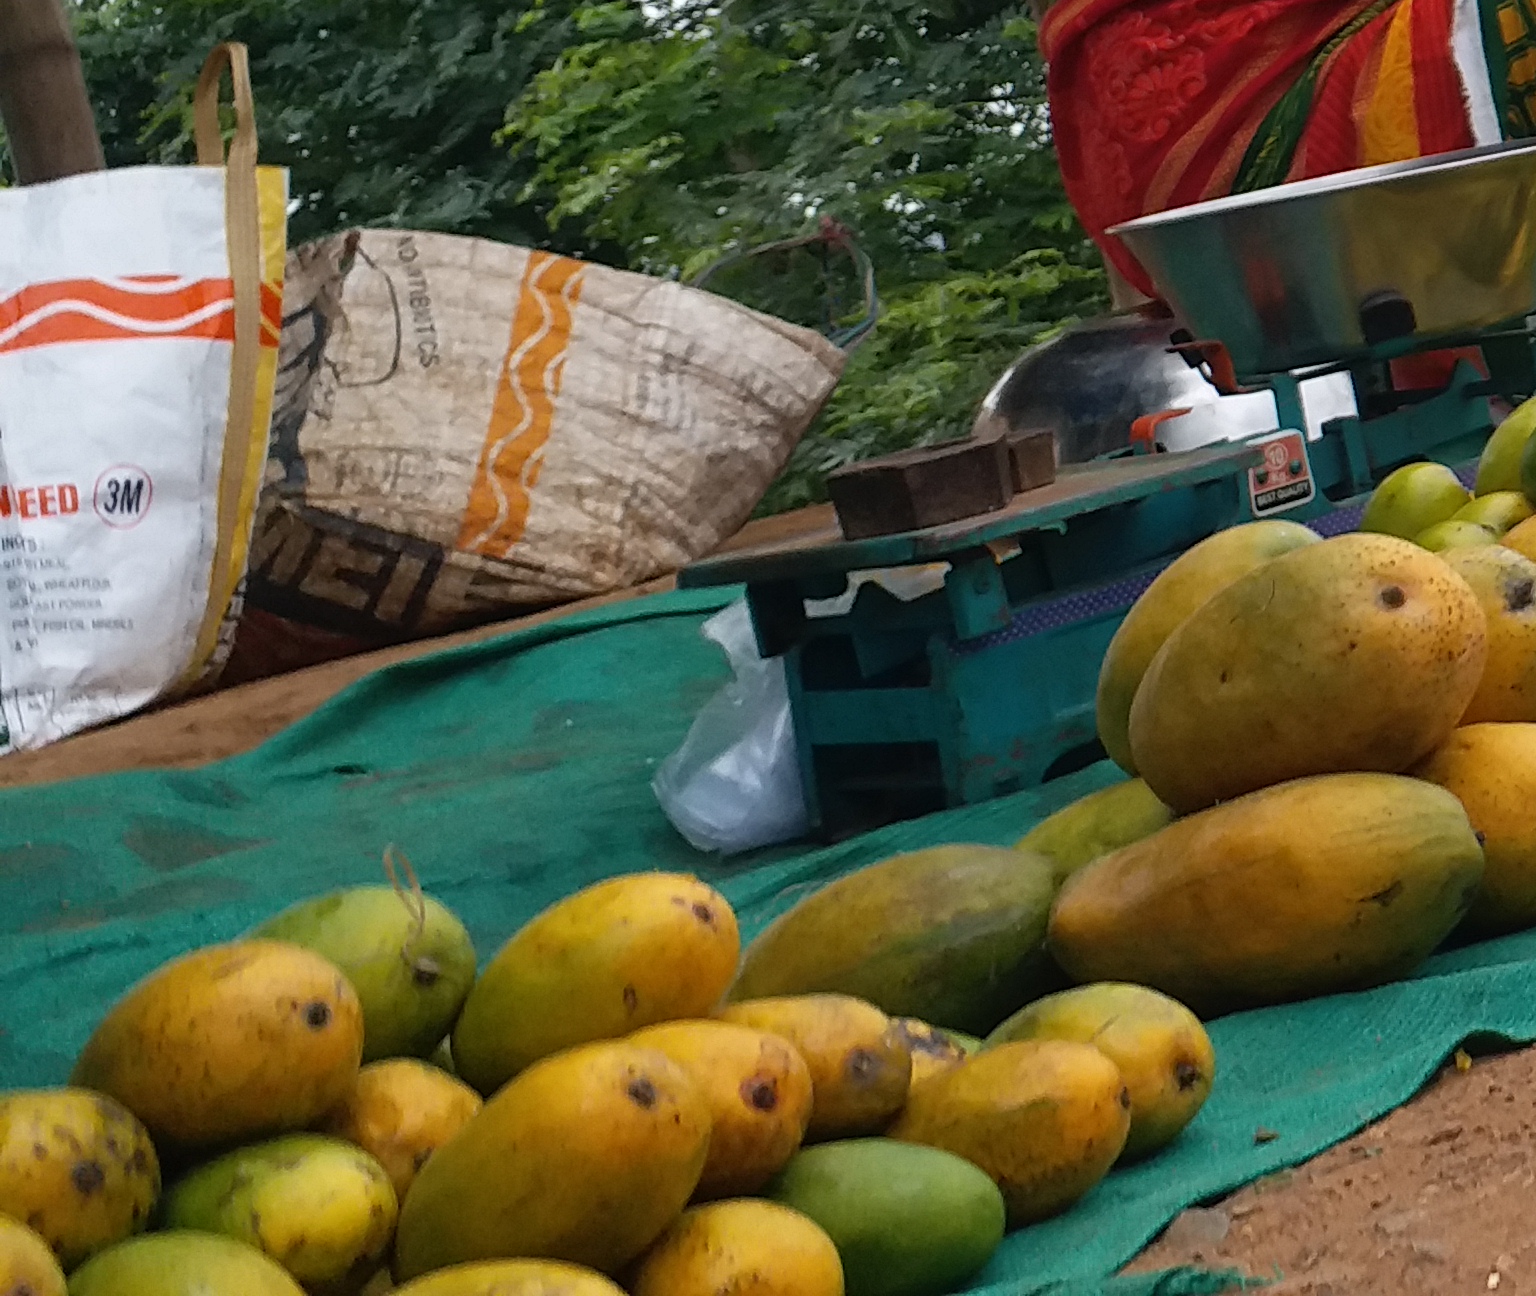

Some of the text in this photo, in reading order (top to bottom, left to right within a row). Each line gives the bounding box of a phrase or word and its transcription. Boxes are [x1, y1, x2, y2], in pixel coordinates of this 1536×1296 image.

[104, 477, 144, 515] 3M
[1256, 481, 1309, 507] BEST QUALITY
